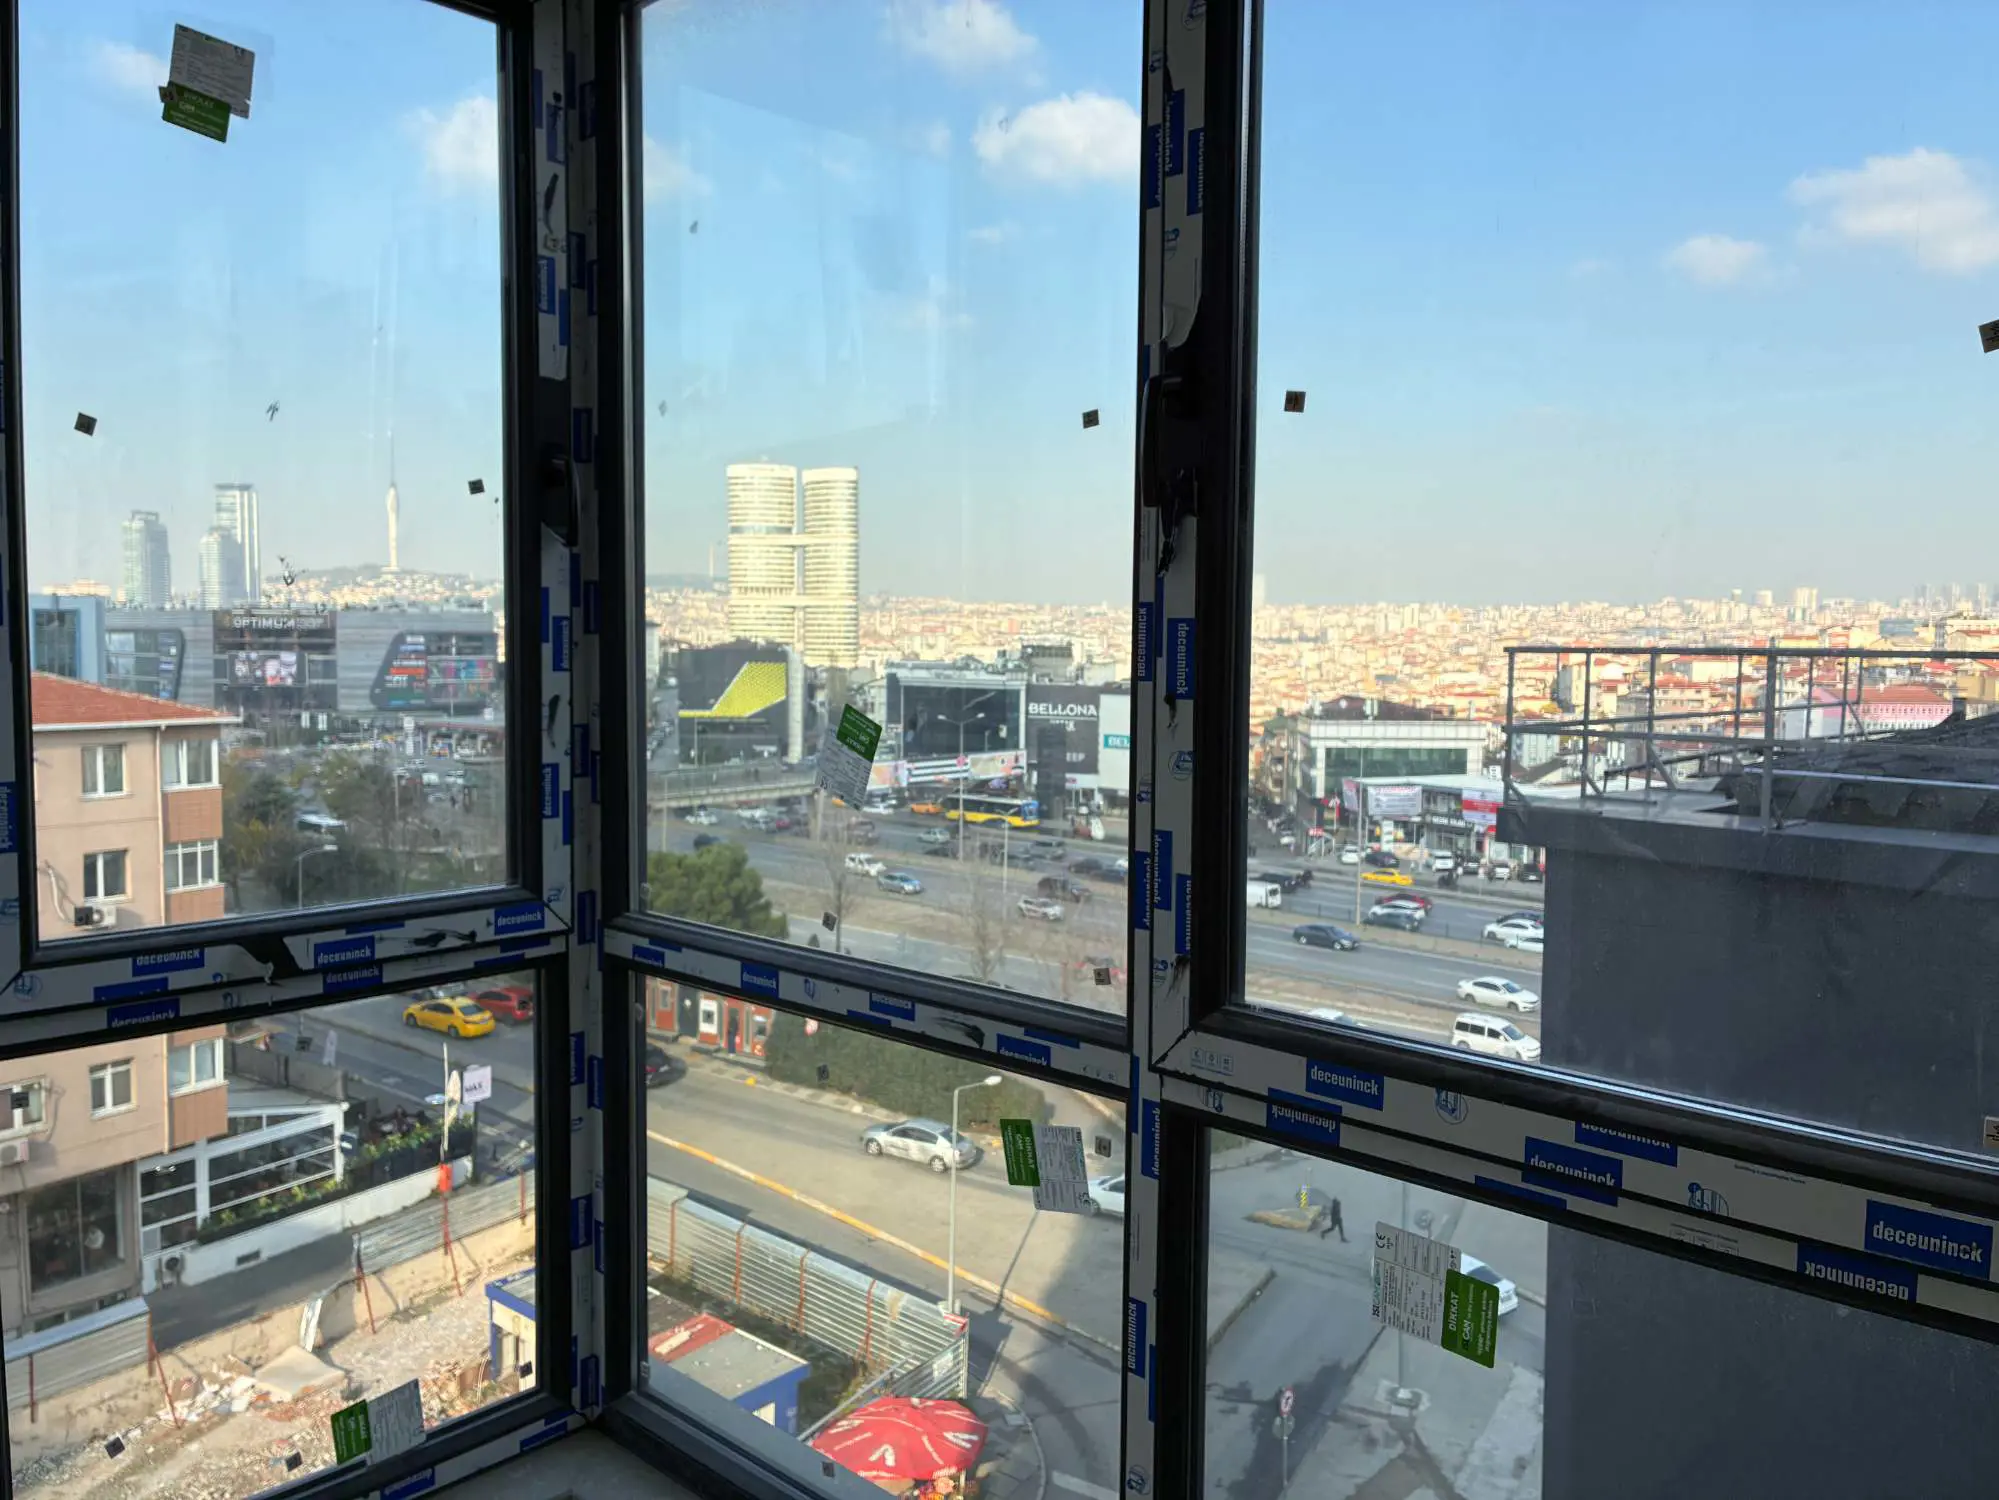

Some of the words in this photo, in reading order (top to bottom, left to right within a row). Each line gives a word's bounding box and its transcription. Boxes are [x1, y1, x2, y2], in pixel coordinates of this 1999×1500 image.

[1176, 623, 1190, 694] deceuninck
[1028, 702, 1097, 717] BELLONA
[497, 909, 542, 929] deceuninck
[317, 944, 373, 965] deceuninck
[1310, 1065, 1379, 1096] deceuninck
[1271, 1102, 1337, 1133] deceuninck
[1872, 1220, 1984, 1264] deceuninck
[1804, 1260, 1909, 1303] deceuninck
[1448, 1291, 1459, 1332] DİKKAT
